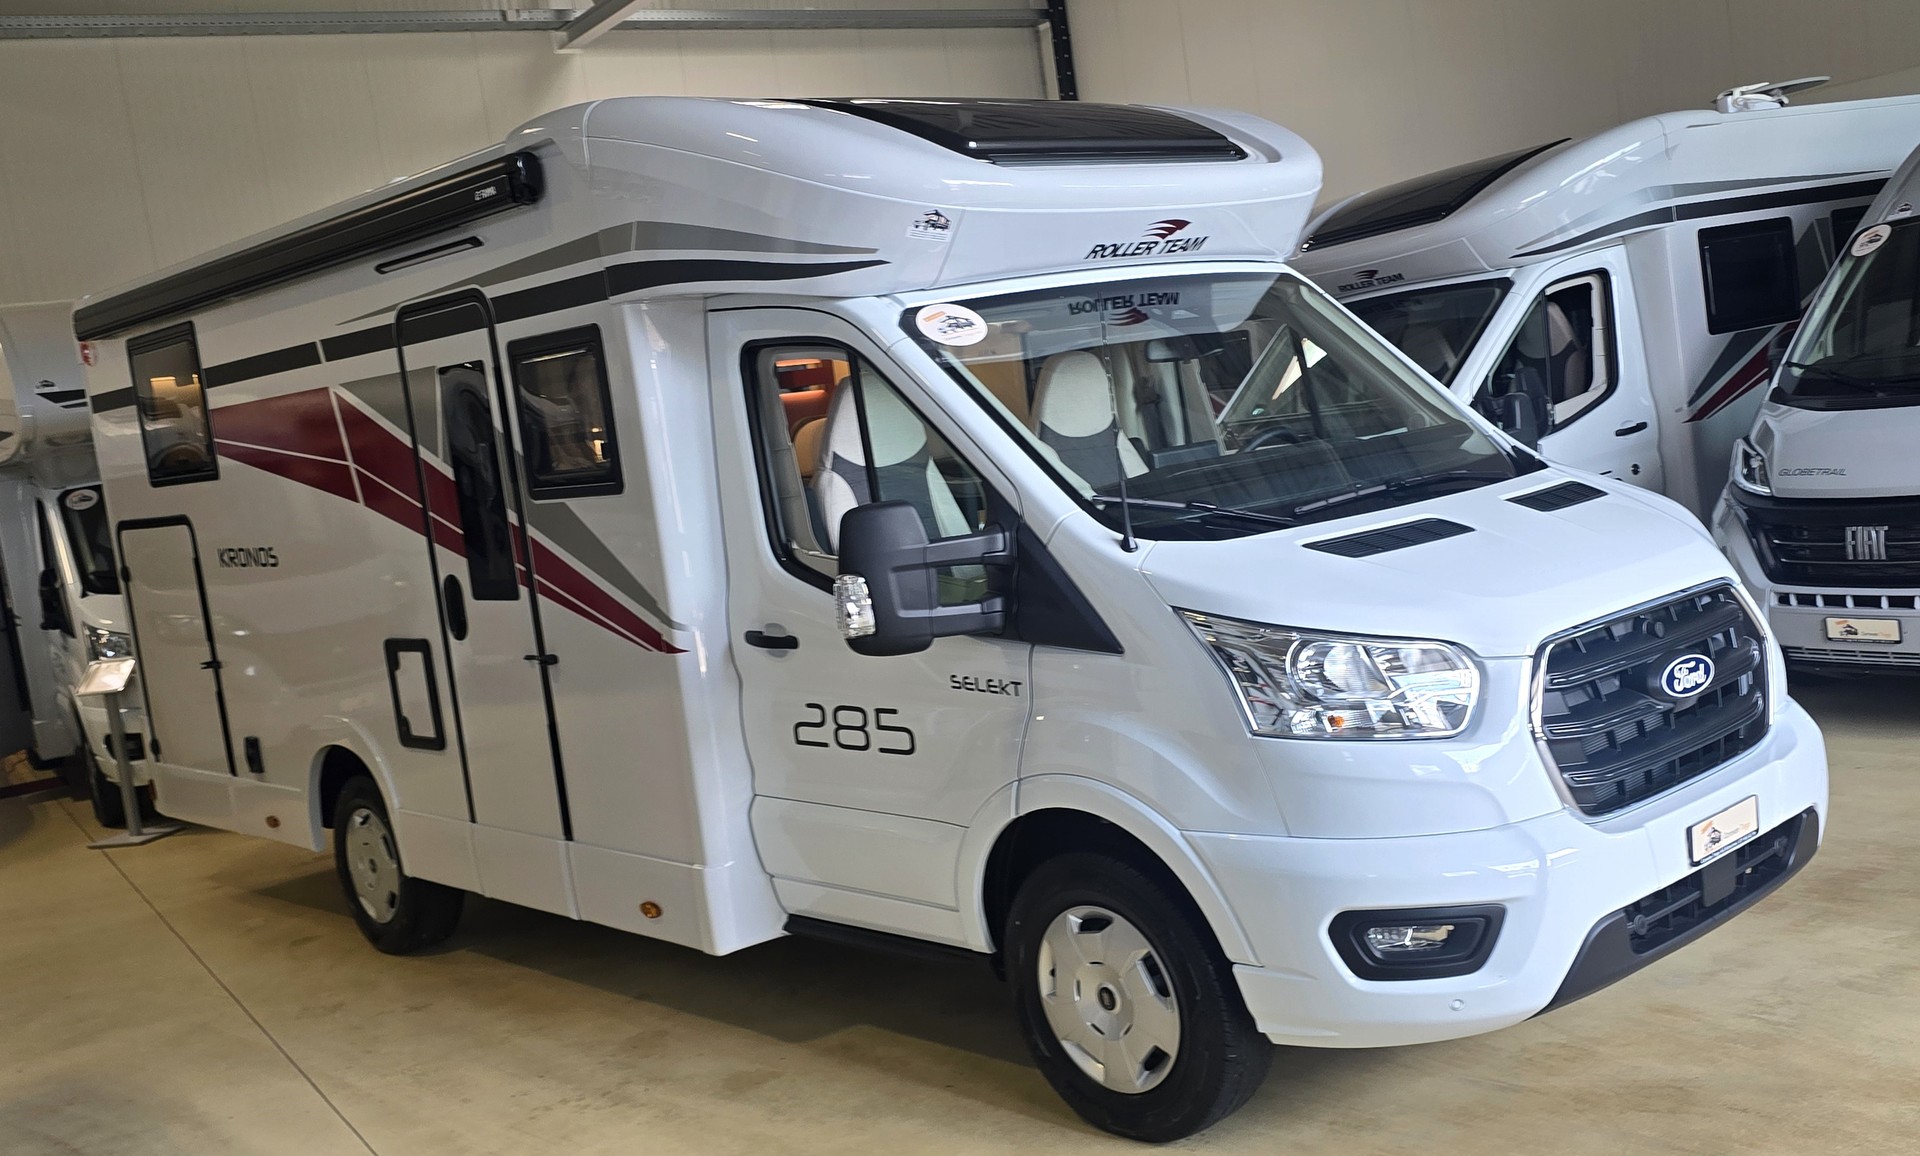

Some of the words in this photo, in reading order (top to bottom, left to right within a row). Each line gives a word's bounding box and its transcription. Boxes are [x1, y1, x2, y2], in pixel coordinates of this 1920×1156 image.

[1084, 240, 1159, 259] ROLLER
[1157, 236, 1209, 254] TEAM
[1337, 279, 1376, 292] ROLLER
[1374, 272, 1404, 285] TEAM
[1778, 468, 1847, 476] GLOBETRAIL
[1845, 525, 1888, 560] FIAT
[217, 547, 279, 568] KRONOS
[950, 674, 1022, 697] SELEKT
[1674, 660, 1707, 692] Ford
[794, 702, 916, 755] 285
